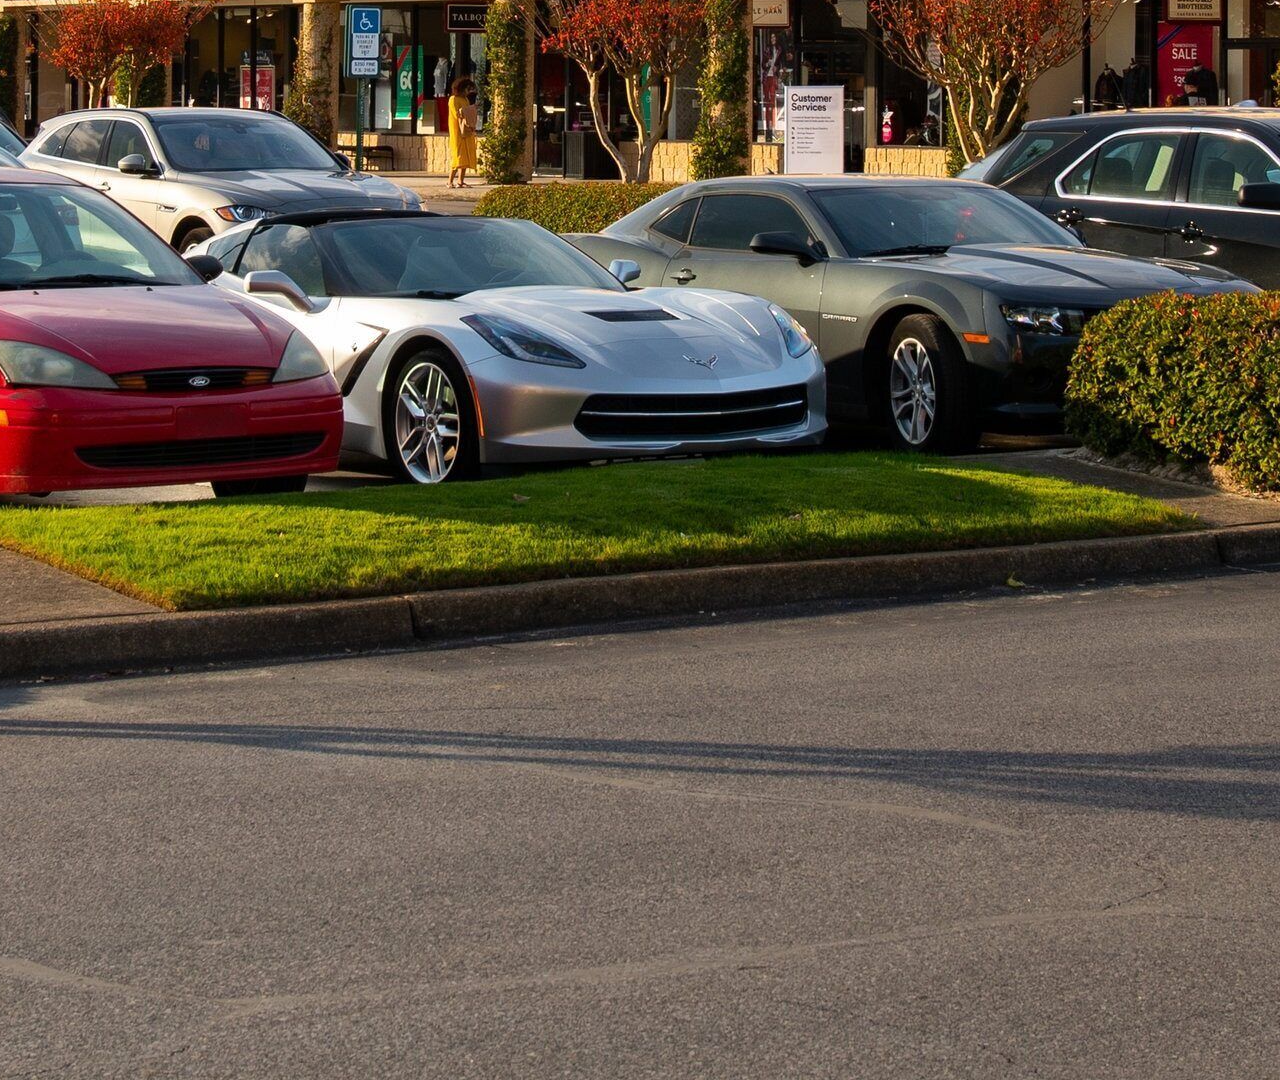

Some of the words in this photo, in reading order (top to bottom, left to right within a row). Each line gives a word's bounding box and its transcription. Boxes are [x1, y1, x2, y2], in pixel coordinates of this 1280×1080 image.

[452, 13, 487, 22] TALBOT
[1172, 48, 1197, 60] SALE
[791, 93, 832, 102] Customer
[791, 102, 827, 111] Services
[822, 313, 858, 323] CAMARO
